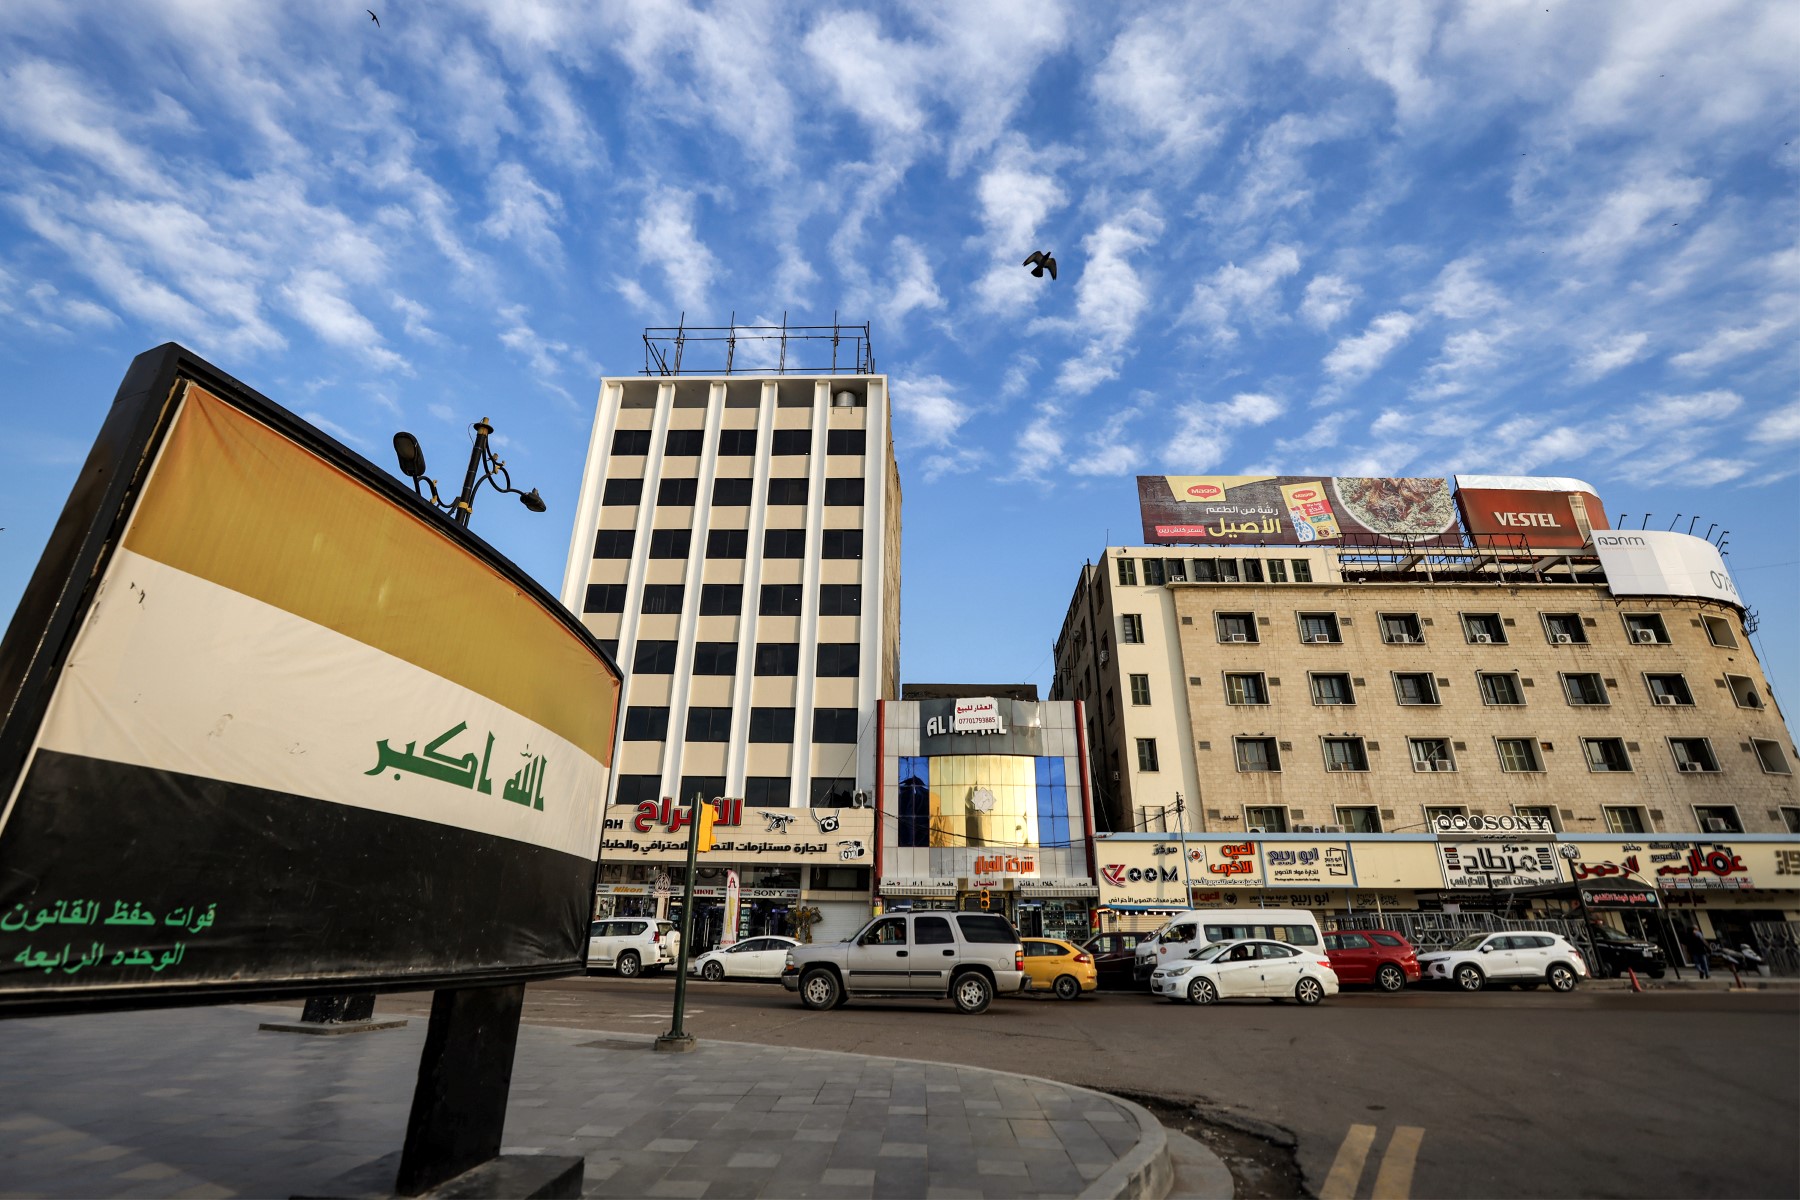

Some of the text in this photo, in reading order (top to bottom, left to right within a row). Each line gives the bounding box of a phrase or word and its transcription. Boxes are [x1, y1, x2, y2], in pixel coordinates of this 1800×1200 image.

[1206, 505, 1238, 515] الطعم
[1240, 506, 1256, 515] من
[1493, 511, 1561, 528] VESTEL
[1208, 515, 1282, 538] الأصيل
[956, 704, 973, 714] للبيع
[926, 715, 947, 737] AL
[1482, 815, 1548, 831] SONY
[735, 841, 792, 854] مستلزمات
[793, 841, 828, 855] لتجارة
[1152, 843, 1179, 856] مركز
[1221, 841, 1256, 860] العين
[1502, 844, 1519, 853] مركز
[1101, 864, 1179, 887] ZOOM
[612, 886, 643, 894] Nikon
[753, 889, 785, 897] SONY
[0, 899, 217, 933] قوات حفظ القانون
